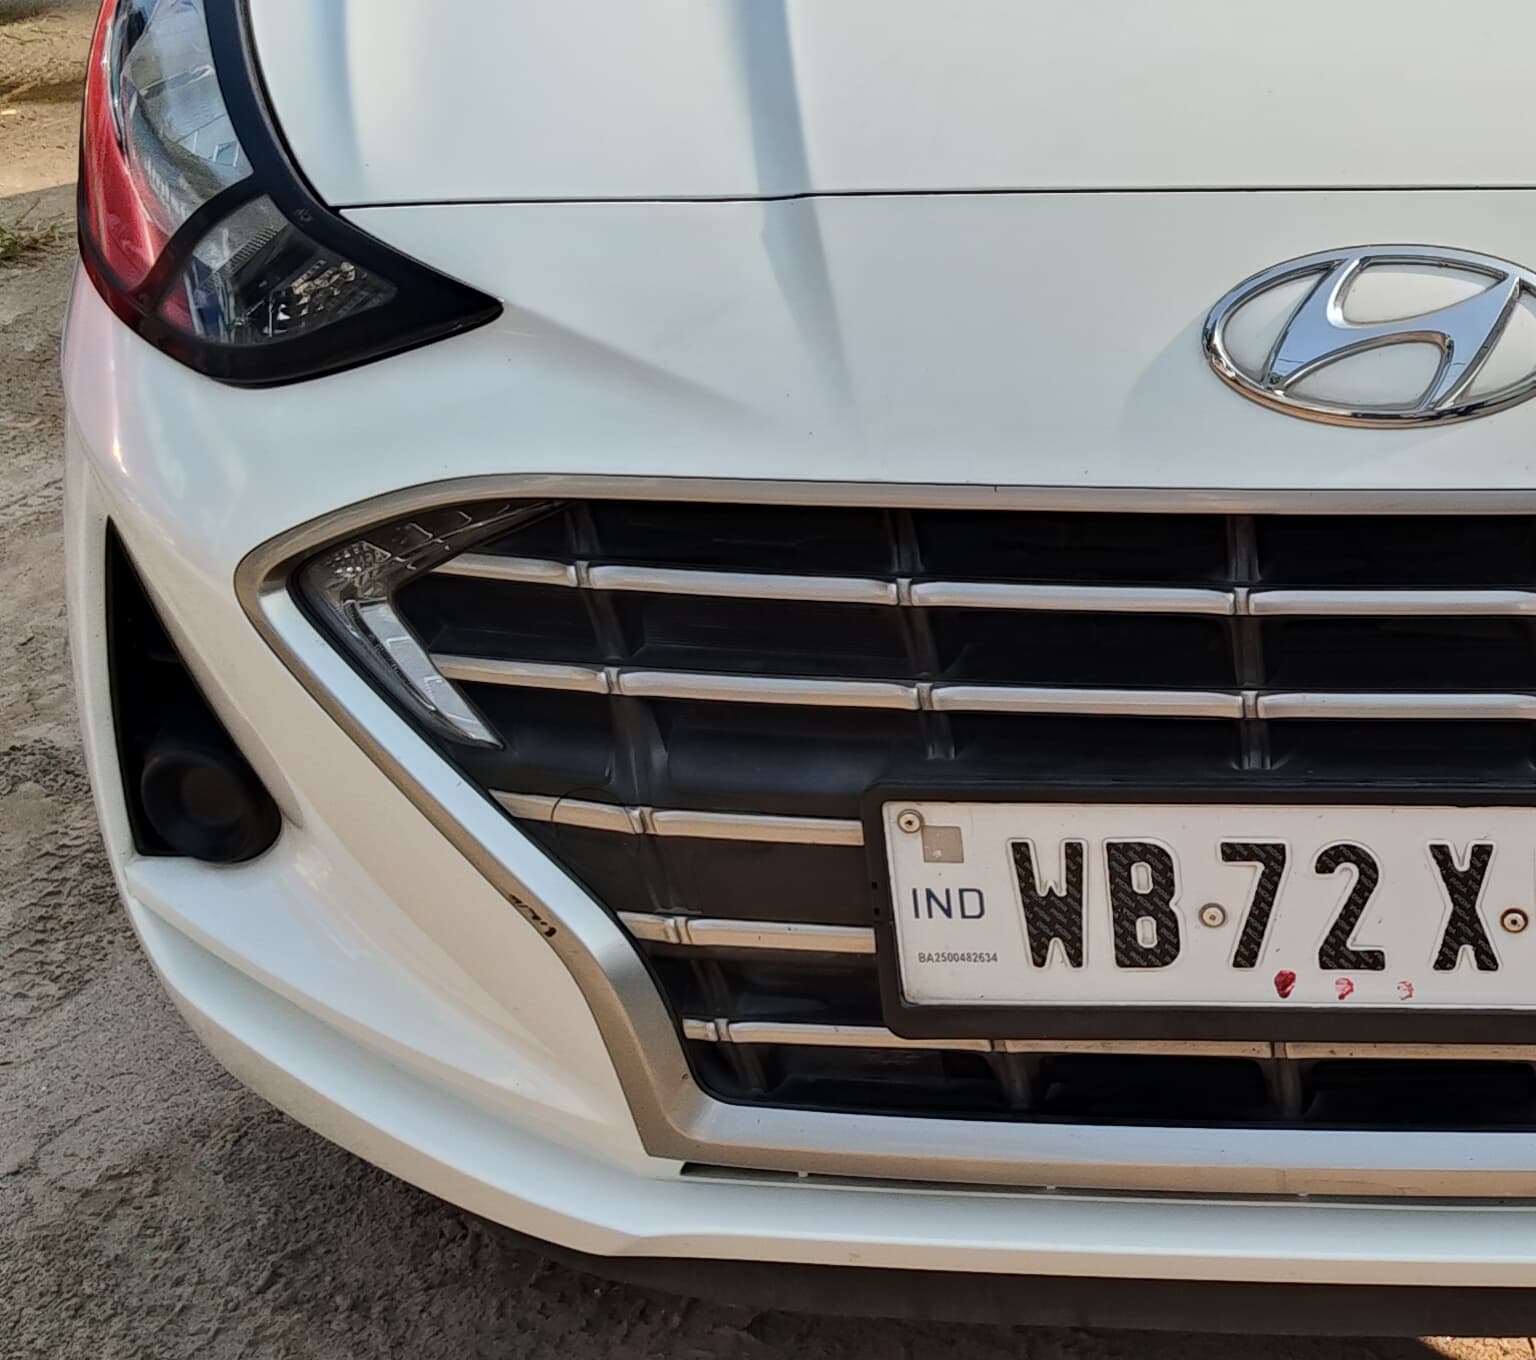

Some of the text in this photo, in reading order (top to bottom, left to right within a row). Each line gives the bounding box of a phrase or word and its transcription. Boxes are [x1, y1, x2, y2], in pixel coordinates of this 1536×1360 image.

[911, 887, 985, 919] IND
[1010, 841, 1182, 969] WB
[1220, 842, 1386, 972] 72
[1428, 843, 1500, 972] X
[917, 951, 998, 963] BA2500482634
